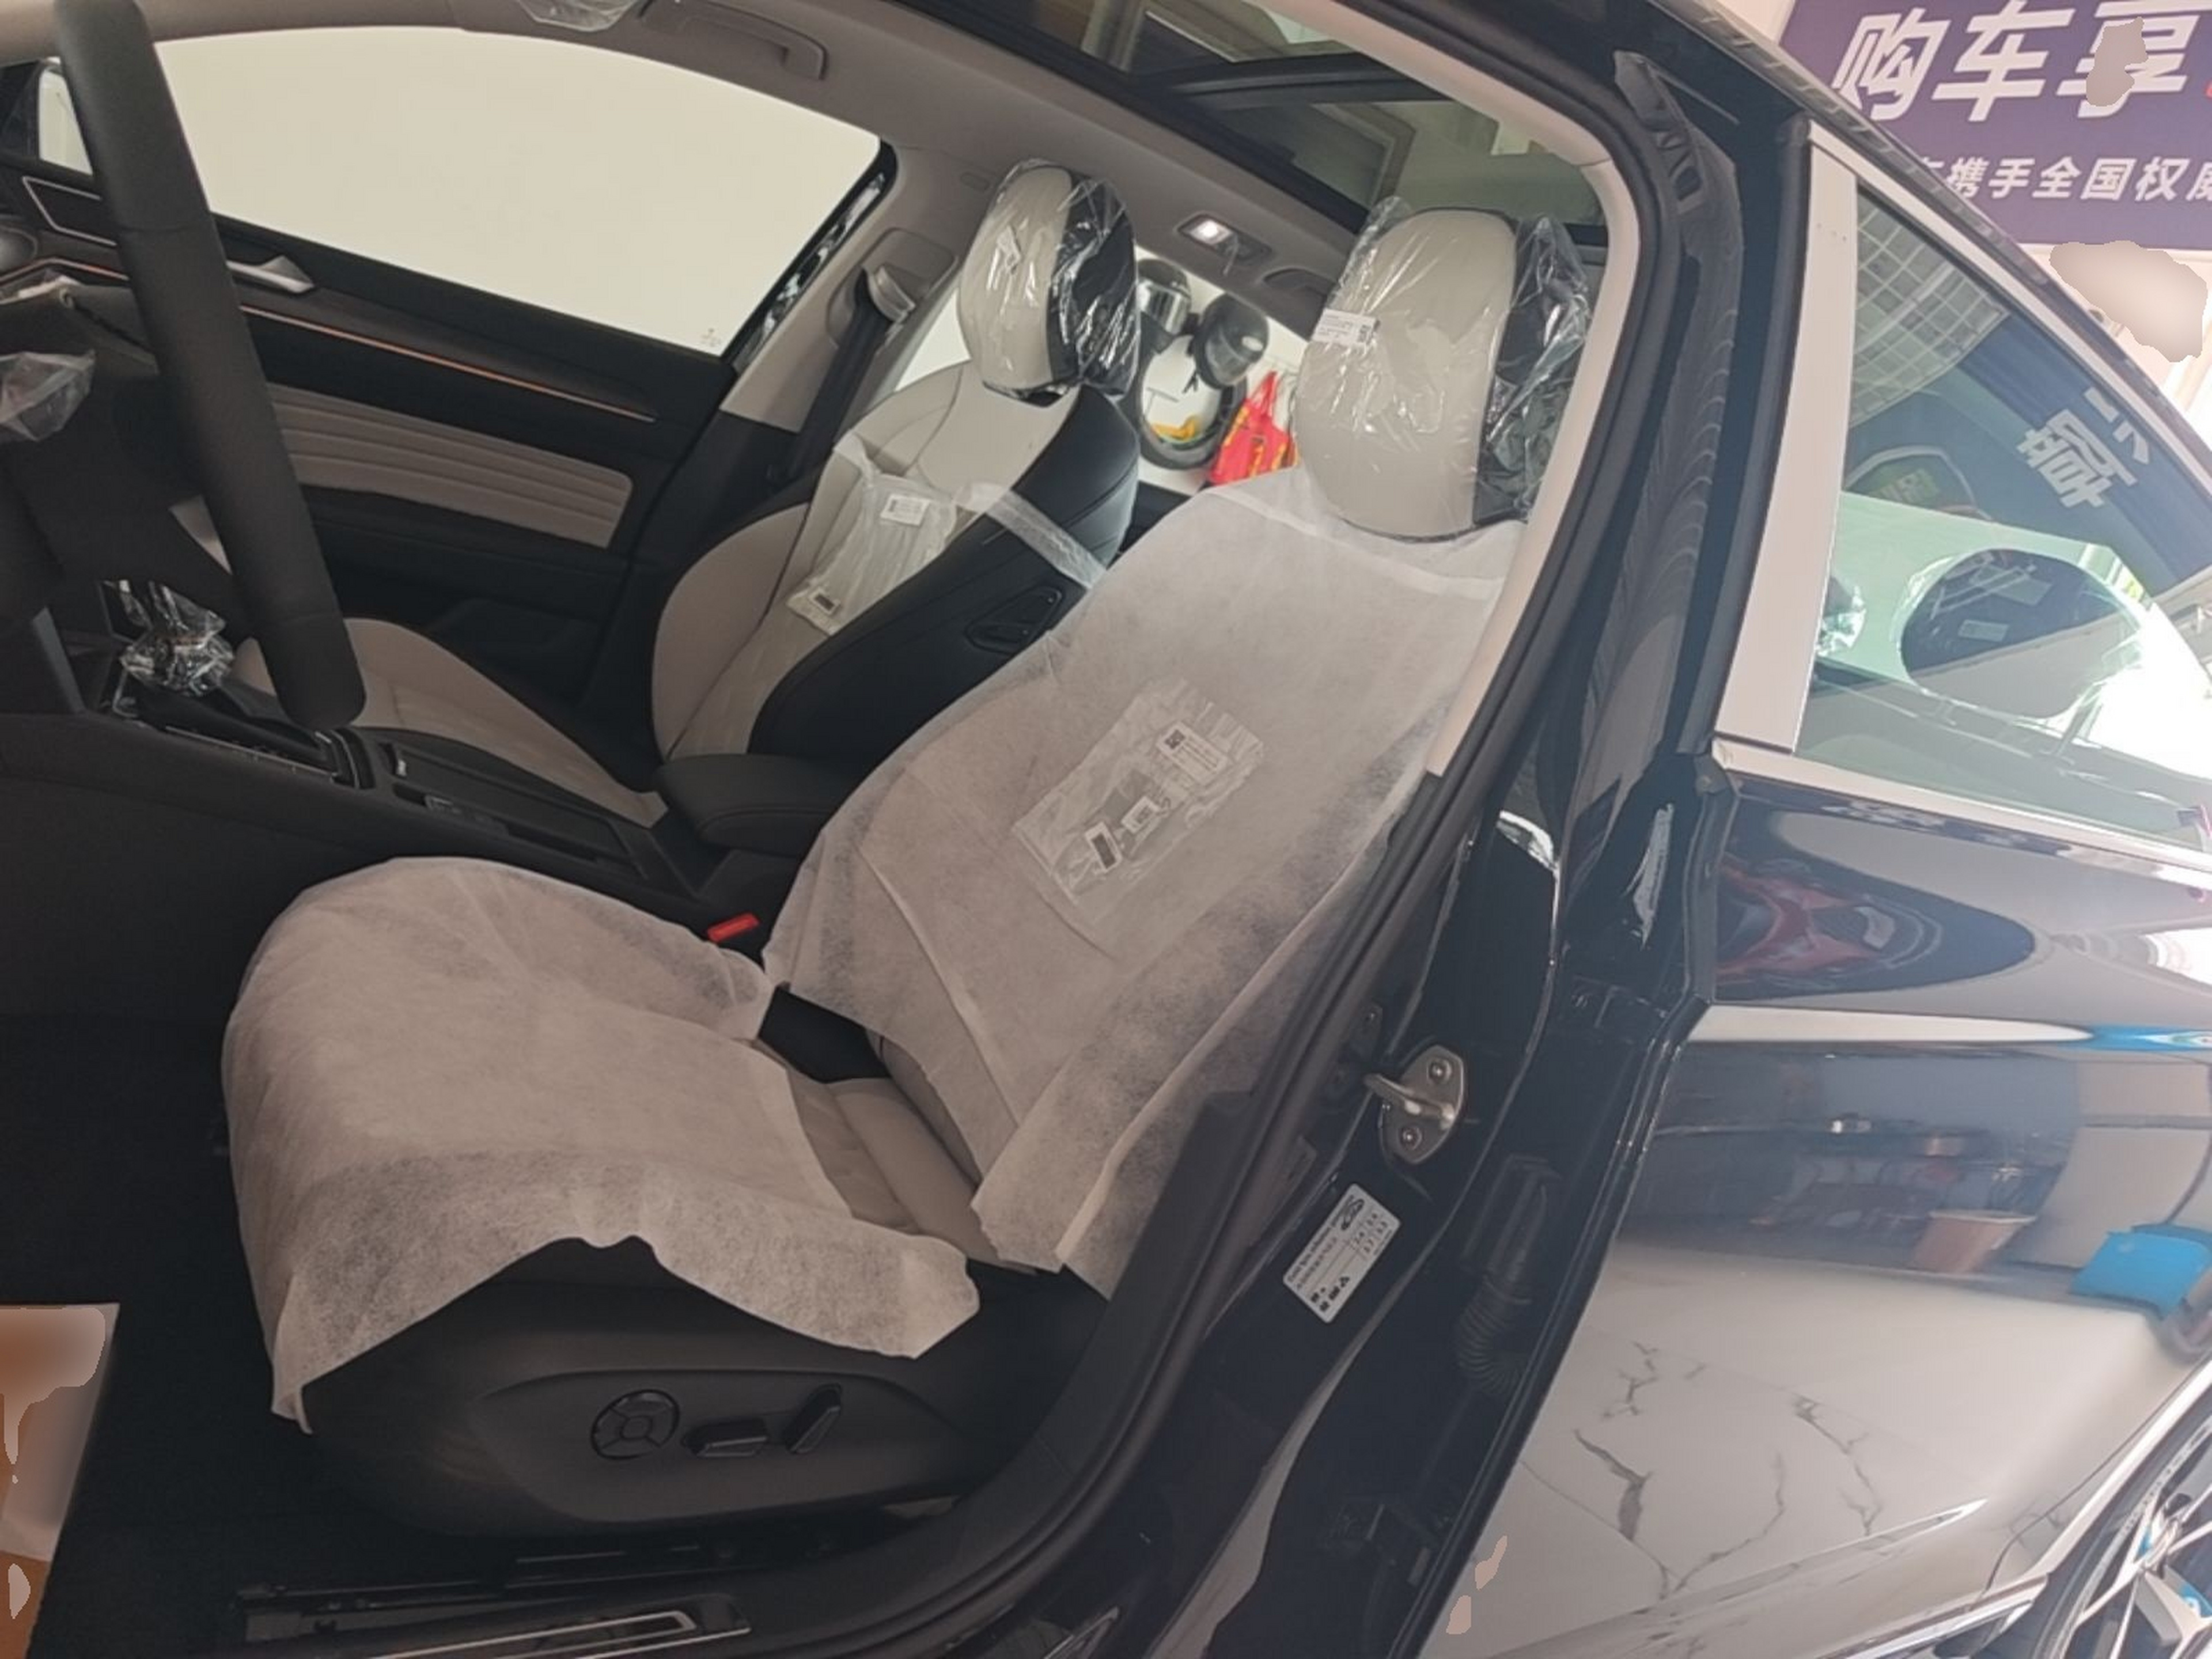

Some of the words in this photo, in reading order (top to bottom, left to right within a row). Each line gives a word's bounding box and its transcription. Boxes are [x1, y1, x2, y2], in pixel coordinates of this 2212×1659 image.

[1922, 156, 2212, 202] 携手全国权
